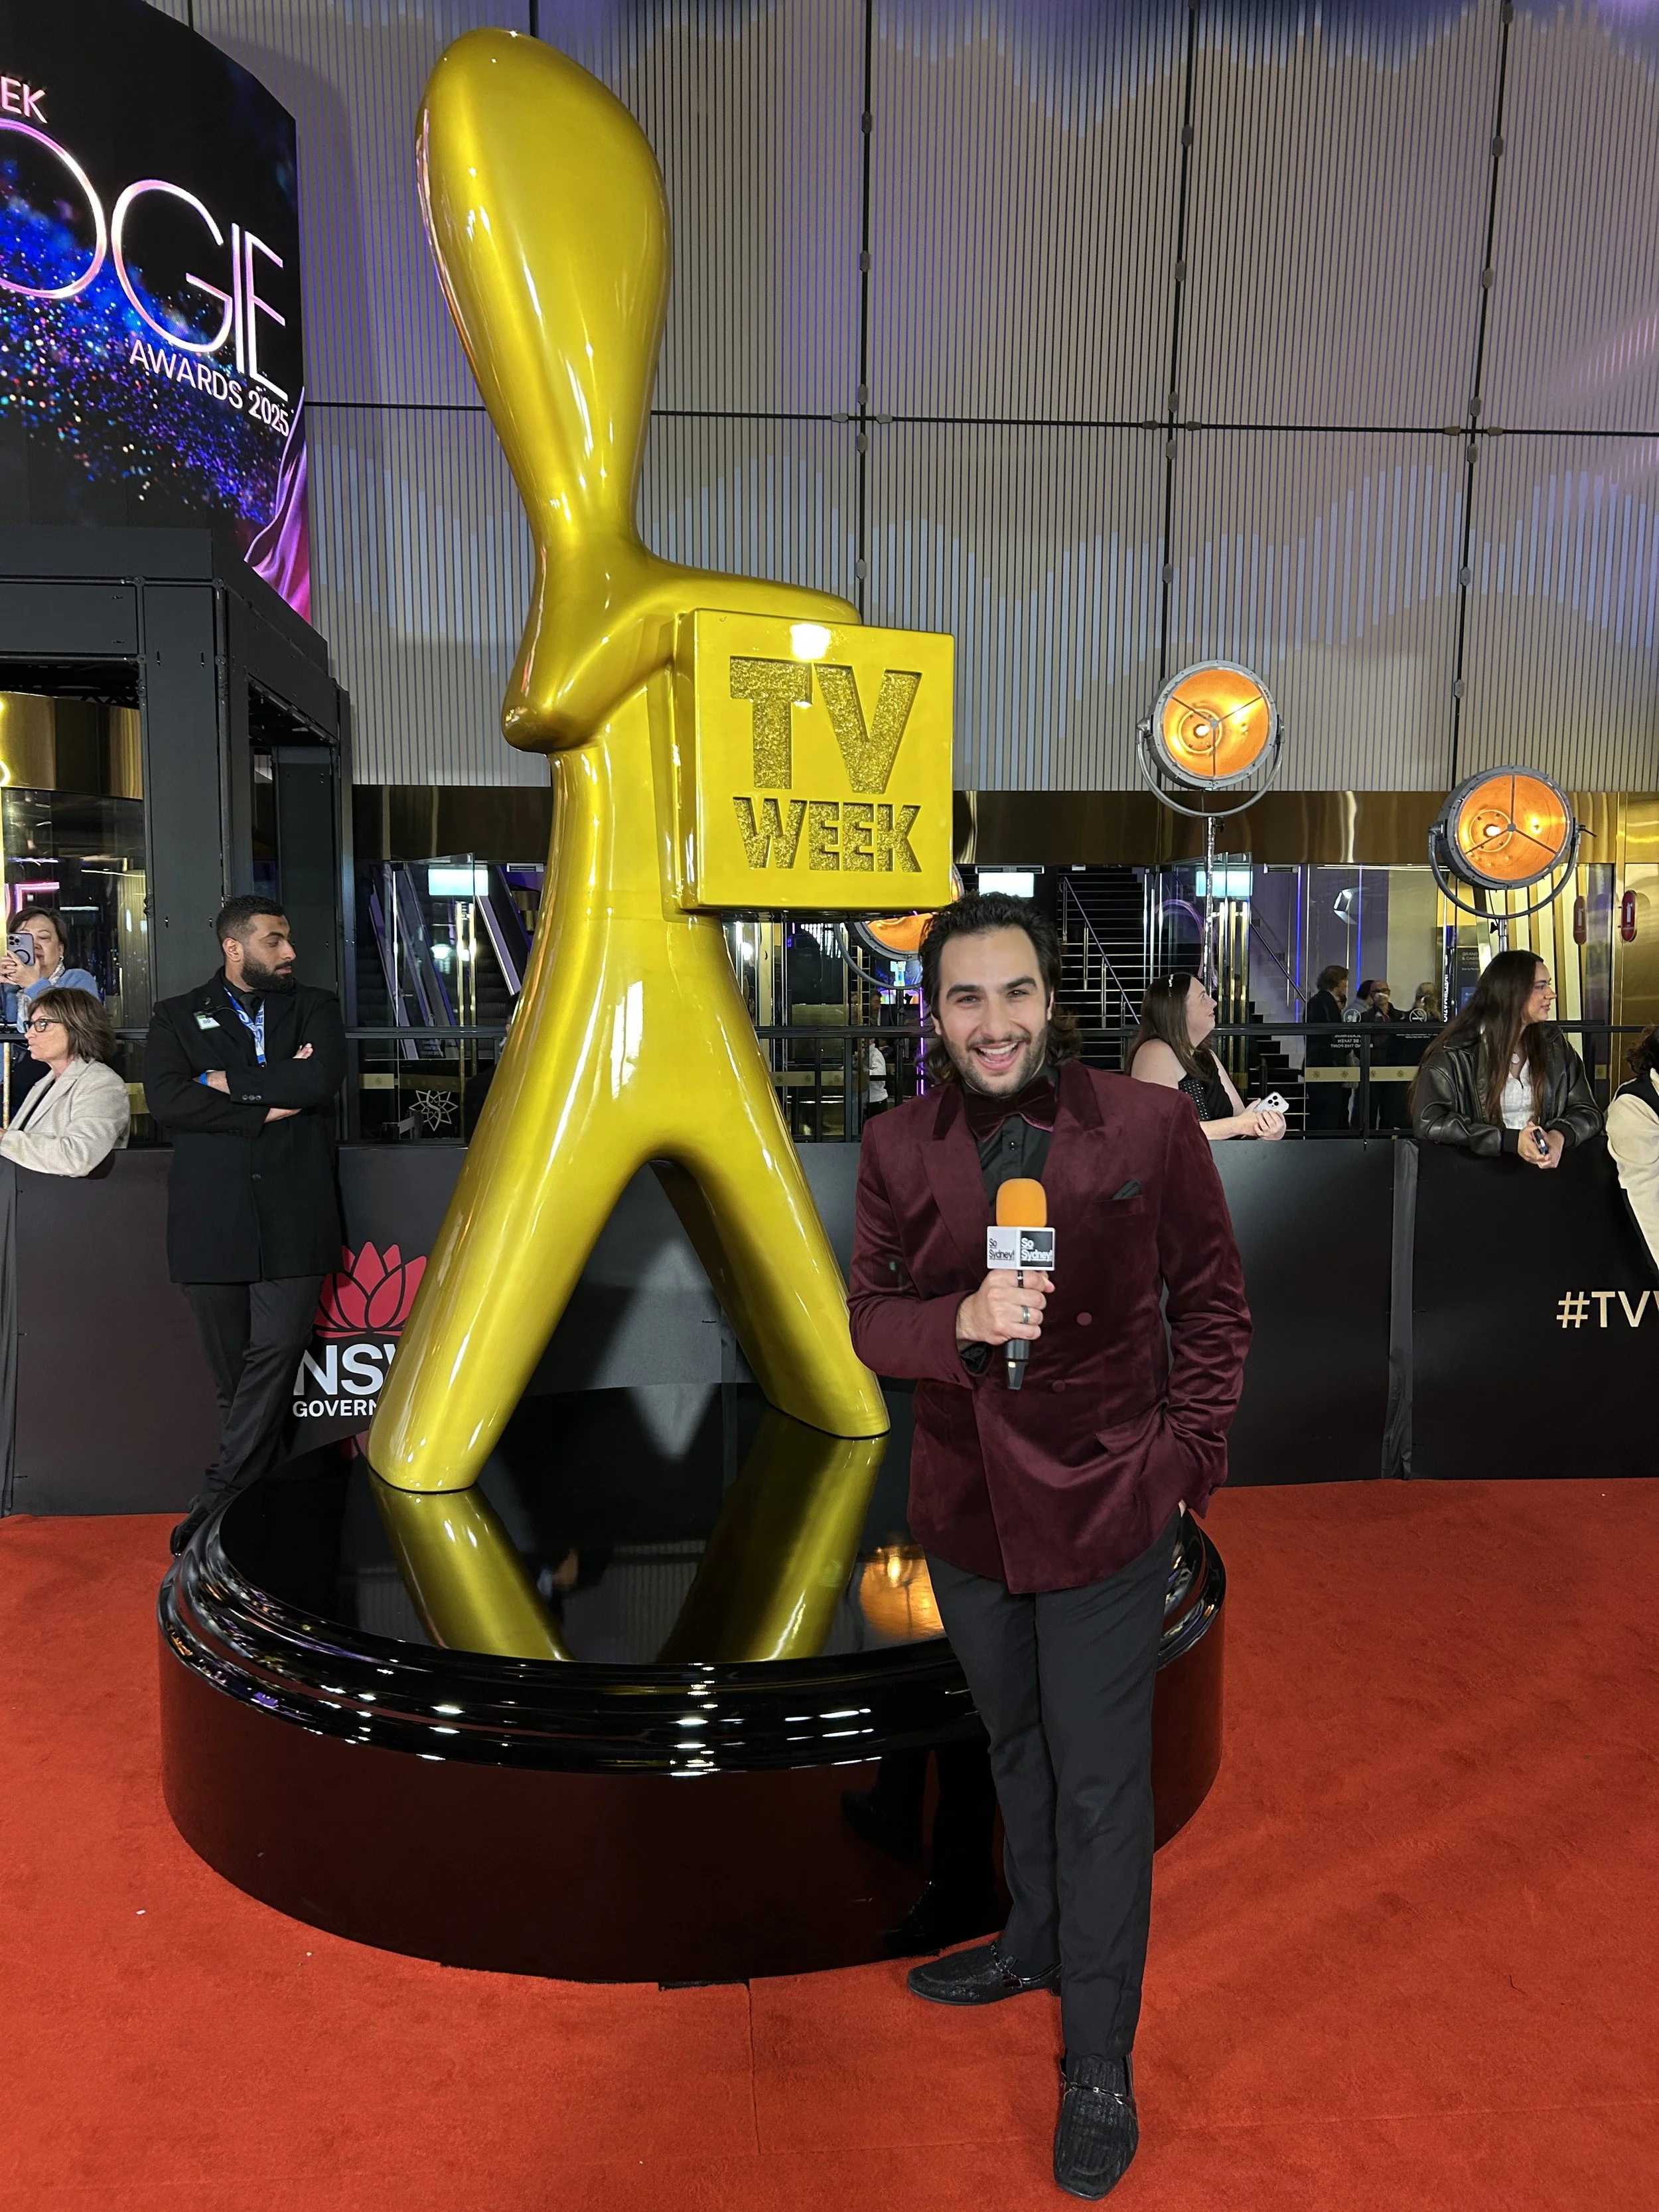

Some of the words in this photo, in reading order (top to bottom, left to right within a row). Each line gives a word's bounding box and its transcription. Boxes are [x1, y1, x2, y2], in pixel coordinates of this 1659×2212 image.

[129, 339, 244, 409] AWARDS
[248, 390, 290, 437] 2025
[730, 656, 923, 794] TV
[733, 796, 923, 873] WEEK
[989, 1238, 997, 1248] So
[989, 1249, 1015, 1261] Sydney!
[1021, 1237, 1035, 1249] So
[1021, 1248, 1052, 1262] Sydney!
[1556, 1291, 1659, 1328] #TV
[293, 1343, 396, 1396] NS
